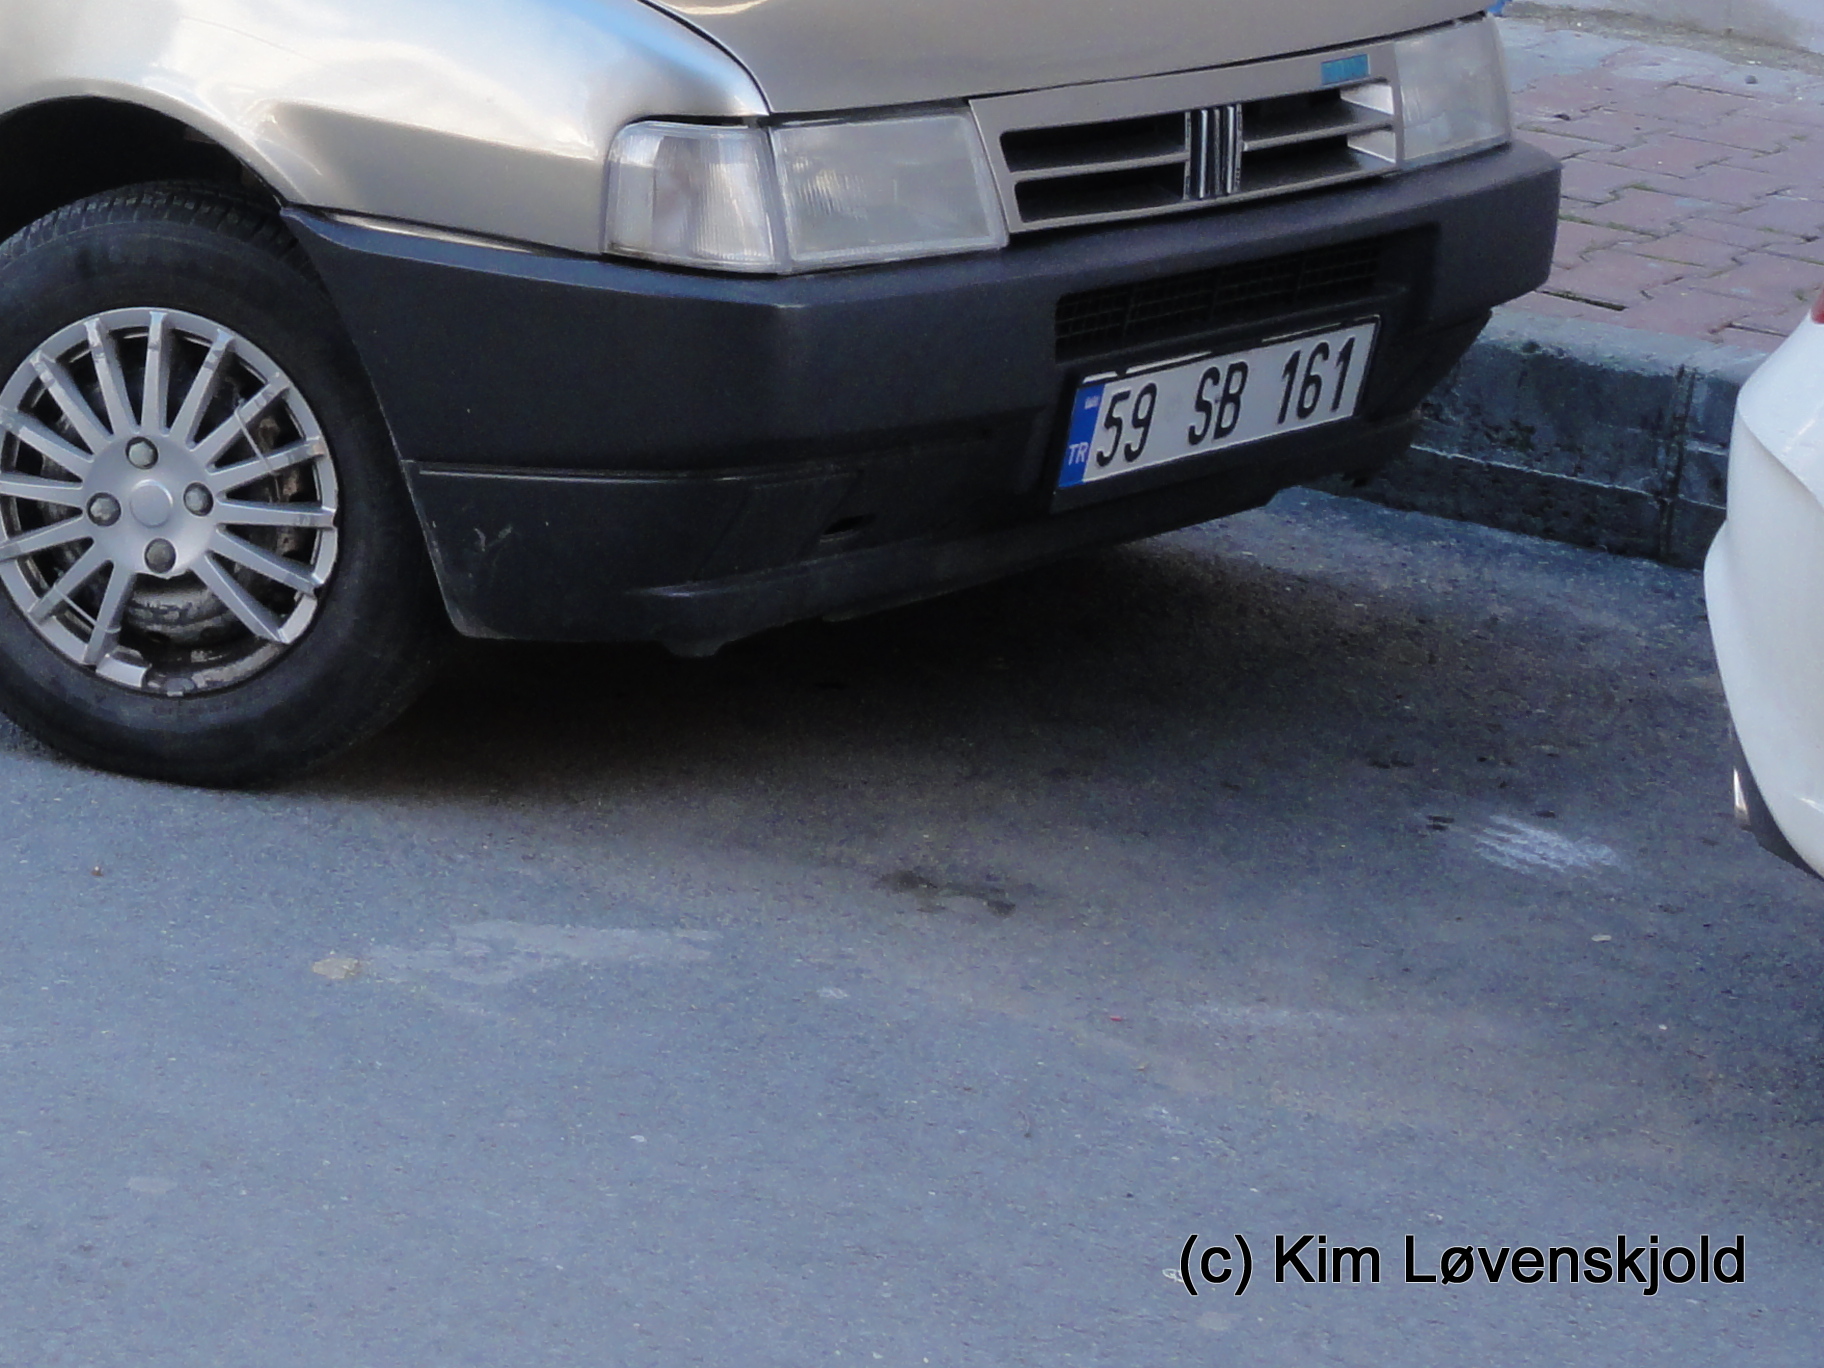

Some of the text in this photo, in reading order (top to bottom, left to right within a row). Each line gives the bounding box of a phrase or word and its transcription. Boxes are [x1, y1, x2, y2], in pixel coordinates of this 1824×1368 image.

[1095, 336, 1356, 467] 59 SB 161
[1068, 441, 1089, 465] TR
